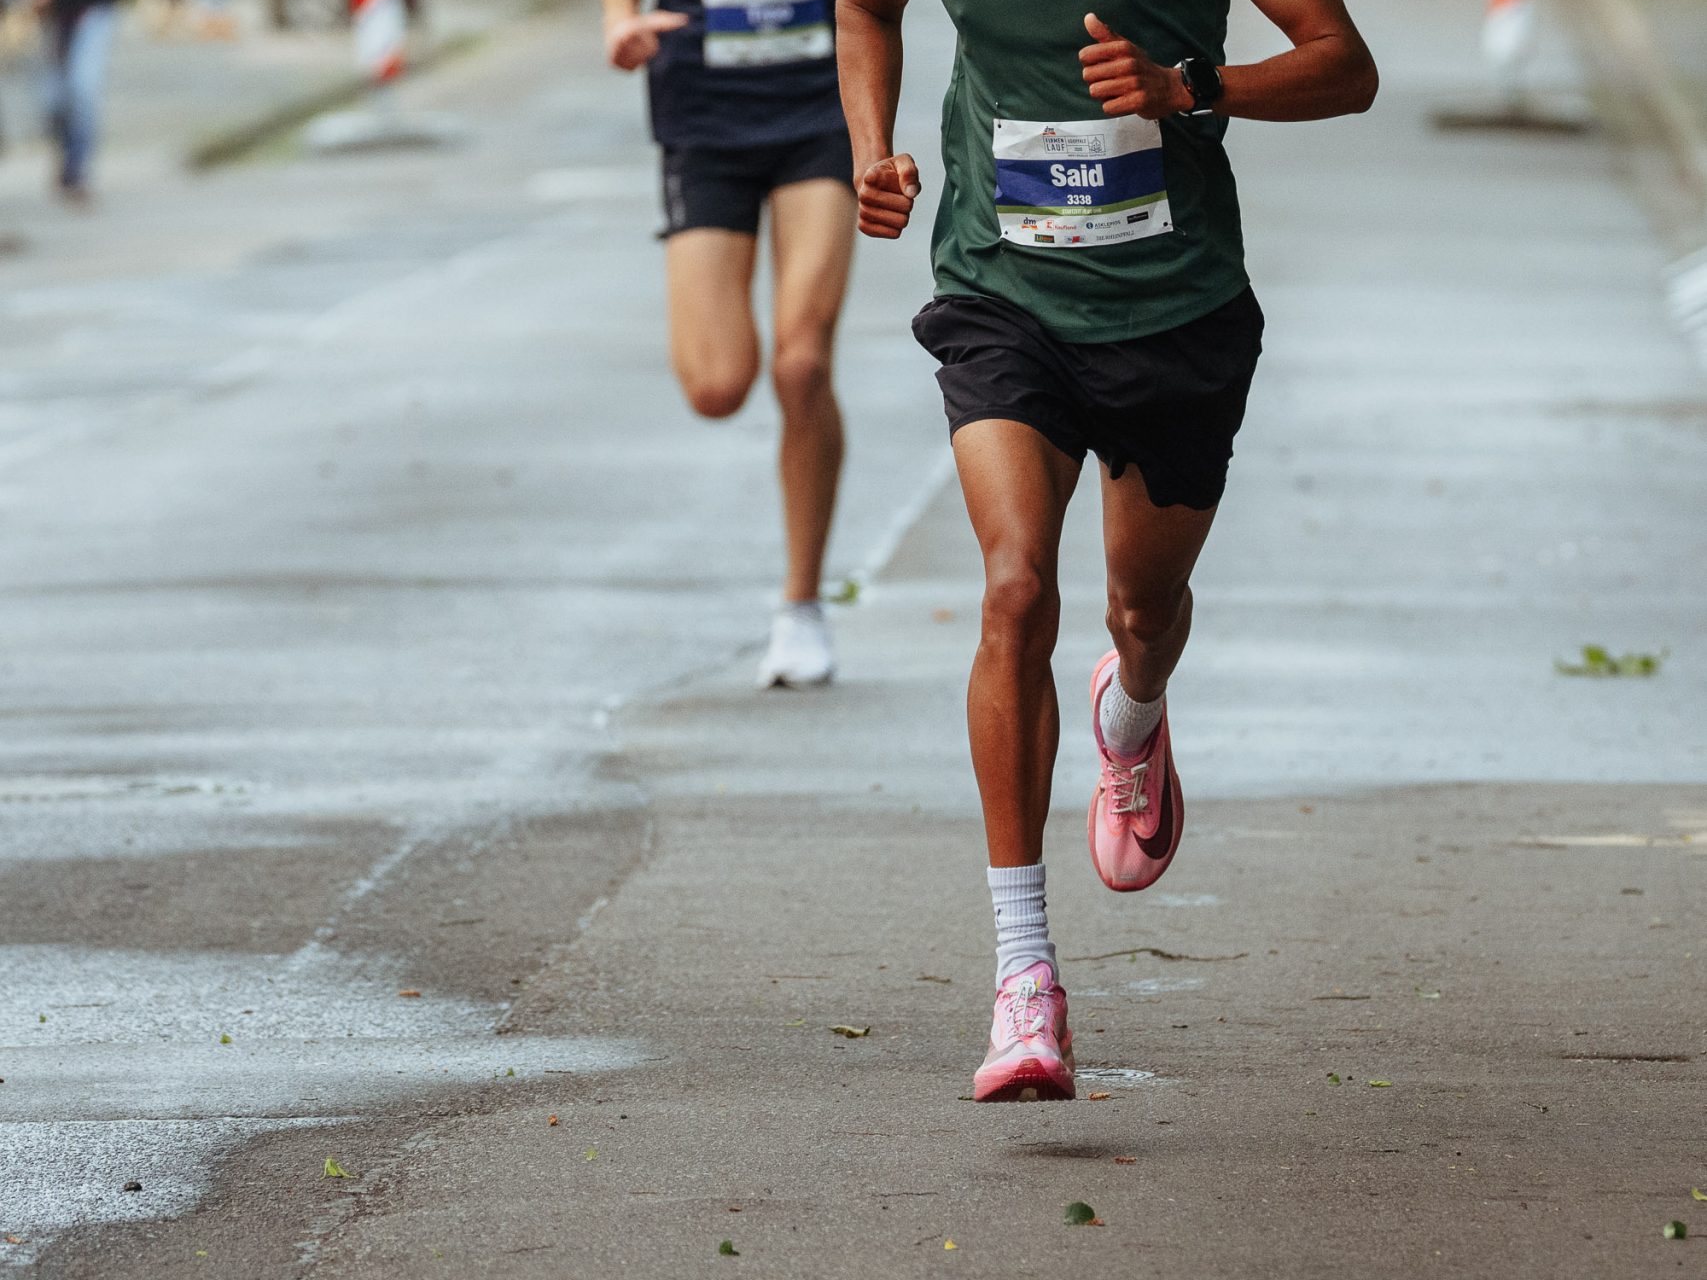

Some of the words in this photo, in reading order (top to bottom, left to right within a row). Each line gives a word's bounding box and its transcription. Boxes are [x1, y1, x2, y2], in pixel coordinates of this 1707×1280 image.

[1046, 143, 1065, 152] LAUF
[1050, 163, 1105, 188] Said
[1066, 194, 1092, 205] 3338
[1023, 217, 1037, 225] dm
